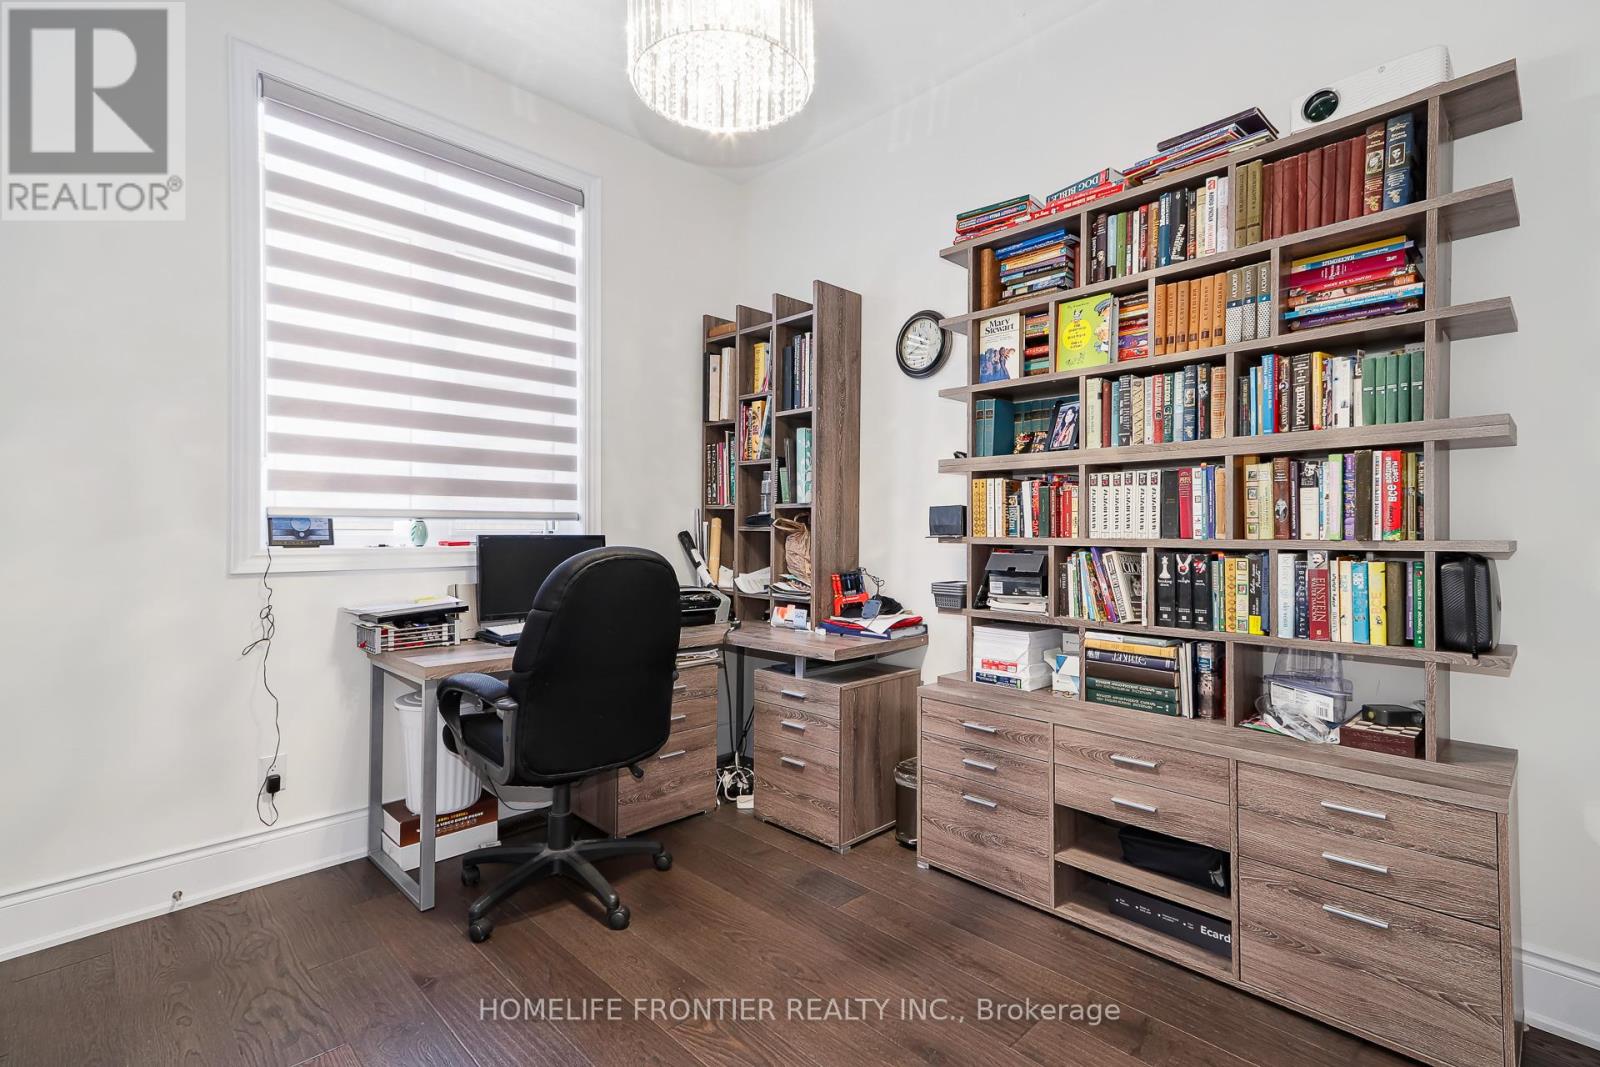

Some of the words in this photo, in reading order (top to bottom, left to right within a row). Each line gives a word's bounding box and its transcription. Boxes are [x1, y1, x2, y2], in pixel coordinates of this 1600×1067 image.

[984, 323, 1014, 336] Stewart
[989, 318, 1010, 329] Mary
[1032, 520, 1040, 536] JVC
[1315, 577, 1327, 622] EINSTEIN
